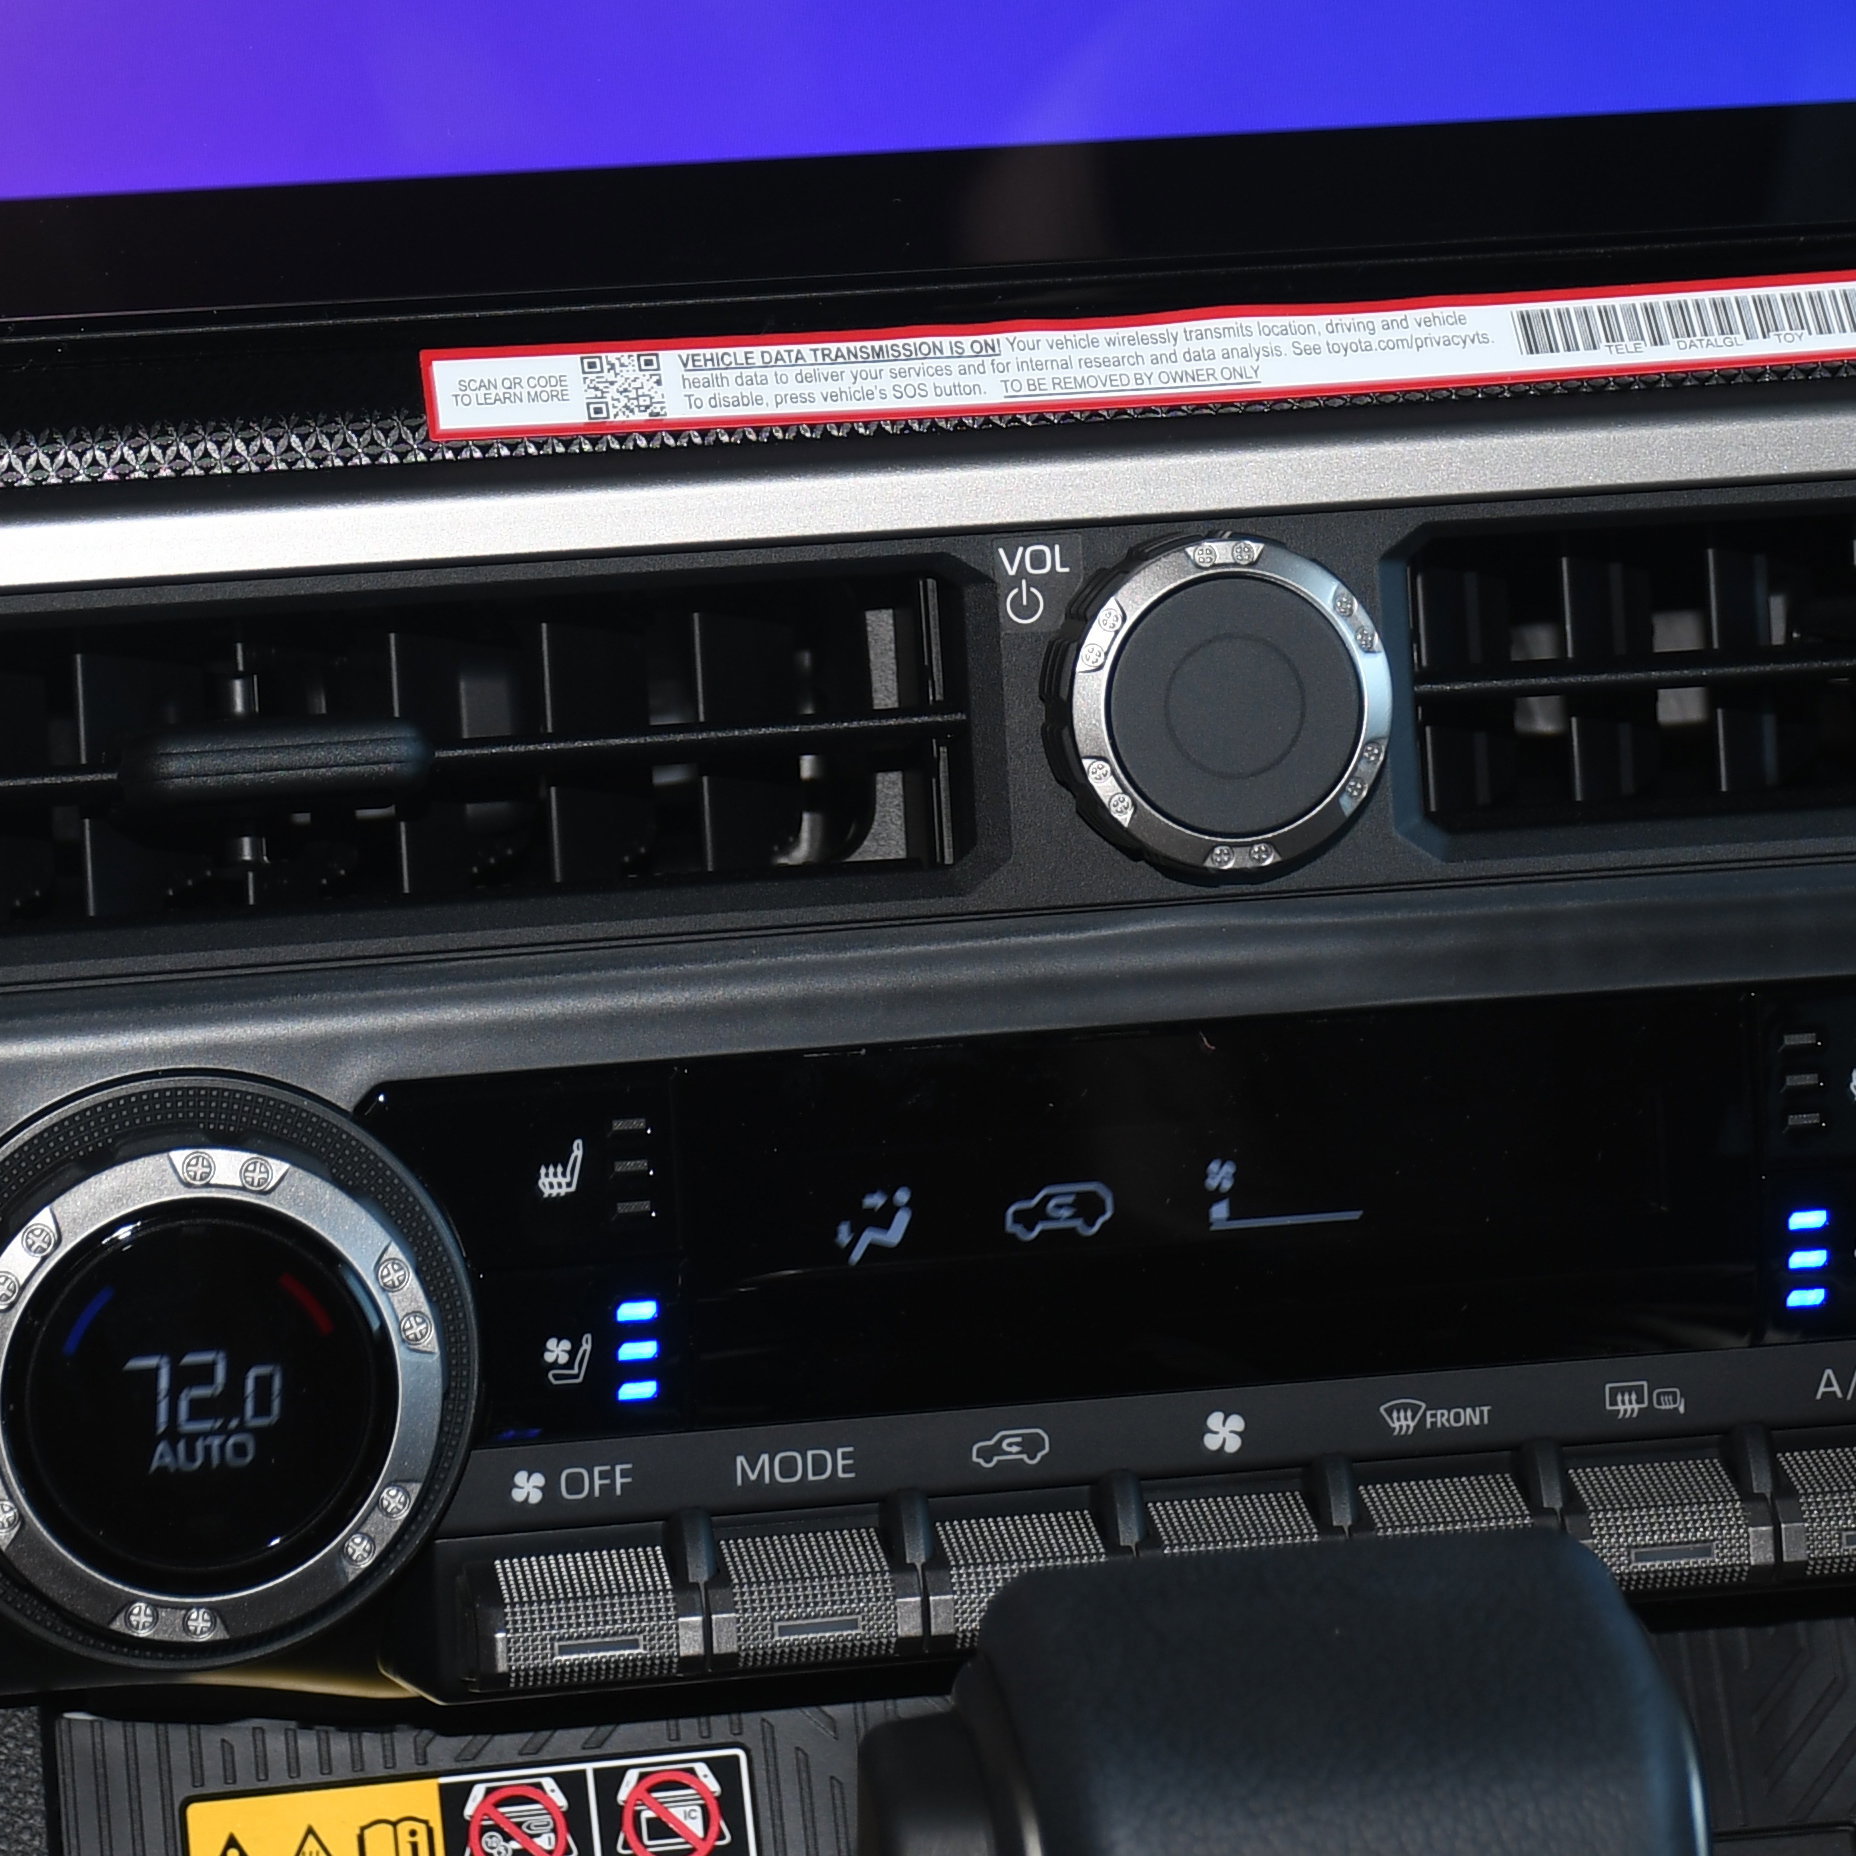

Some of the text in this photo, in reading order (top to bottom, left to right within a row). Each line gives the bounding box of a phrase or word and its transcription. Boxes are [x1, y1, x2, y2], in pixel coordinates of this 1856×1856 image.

[678, 311, 1467, 369] VEHICLE DATA TRANSMISSION IS ON! Your vehicle wirelessly transmits location, driving and vehicle
[1604, 342, 1644, 356] TELE
[1675, 335, 1745, 351] DATALGL
[1773, 331, 1806, 345] TOY
[682, 331, 1495, 390] health data to deliver your services and for internal research and data analysis. See toyota.com/privacyvts.
[452, 389, 570, 407] TO LEARN MORE
[458, 374, 568, 393] SCAN QR CODE
[684, 364, 1261, 410] To disable, press vehicle's SOS button. TO BE REMOVED BY OWNER ONLY
[997, 543, 1071, 576] VOL
[122, 1349, 284, 1436] 72.0
[1425, 1404, 1492, 1430] FRONT
[149, 1433, 255, 1473] AUTO
[735, 1446, 856, 1486] MODE
[559, 1463, 634, 1502] OFF
[683, 1809, 699, 1821] IC
